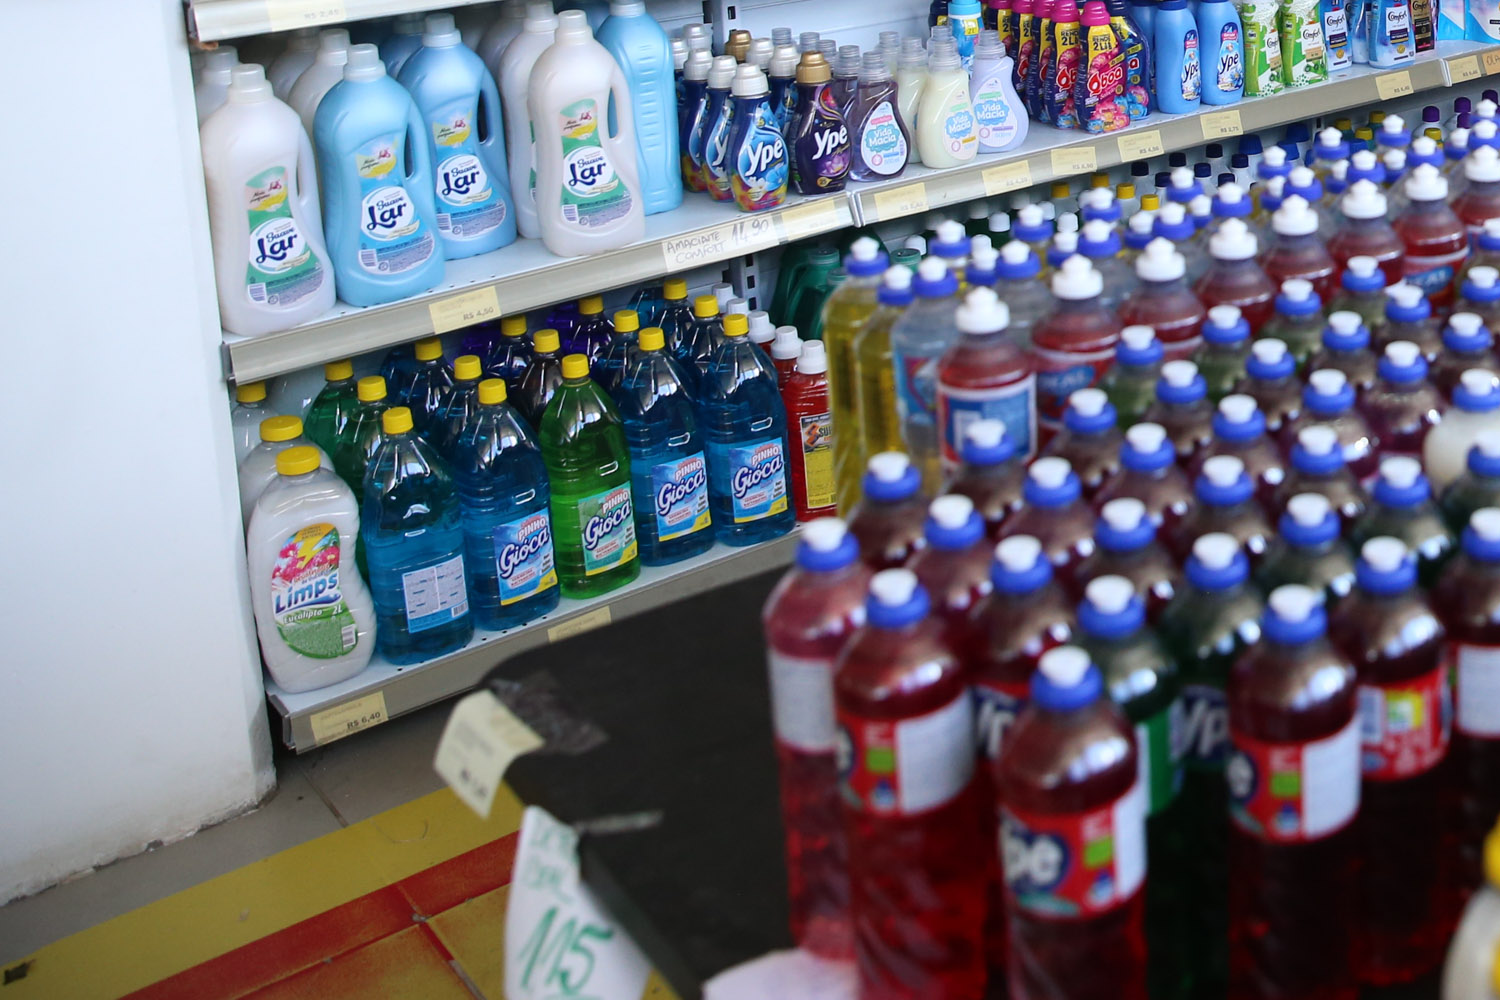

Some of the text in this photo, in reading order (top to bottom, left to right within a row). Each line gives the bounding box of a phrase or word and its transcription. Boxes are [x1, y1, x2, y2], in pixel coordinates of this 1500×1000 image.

[1326, 15, 1346, 34] Comfort
[1387, 9, 1408, 28] Comfort
[1088, 66, 1122, 96] Qboa
[952, 114, 968, 125] Vida
[976, 110, 1006, 120] Macia
[980, 103, 1002, 112] Vida
[812, 124, 848, 160] Ypê
[868, 134, 897, 146] Macia
[874, 128, 892, 136] Vida
[745, 138, 783, 177] Ypê
[442, 168, 480, 197] Lar
[569, 161, 607, 189] Lar
[366, 203, 407, 232] Lar
[256, 235, 298, 265] Lar
[751, 445, 780, 467] PINHO
[674, 458, 702, 481] PINHO
[733, 454, 784, 499] Gióca
[601, 490, 630, 514] PINHO
[657, 464, 705, 516] Gióca
[517, 517, 547, 542] PINHO
[584, 500, 632, 550] Gióca
[499, 525, 550, 579] Gióca
[274, 569, 339, 614] Limps
[283, 608, 323, 625] Eucalipto
[361, 711, 381, 724] 6,40
